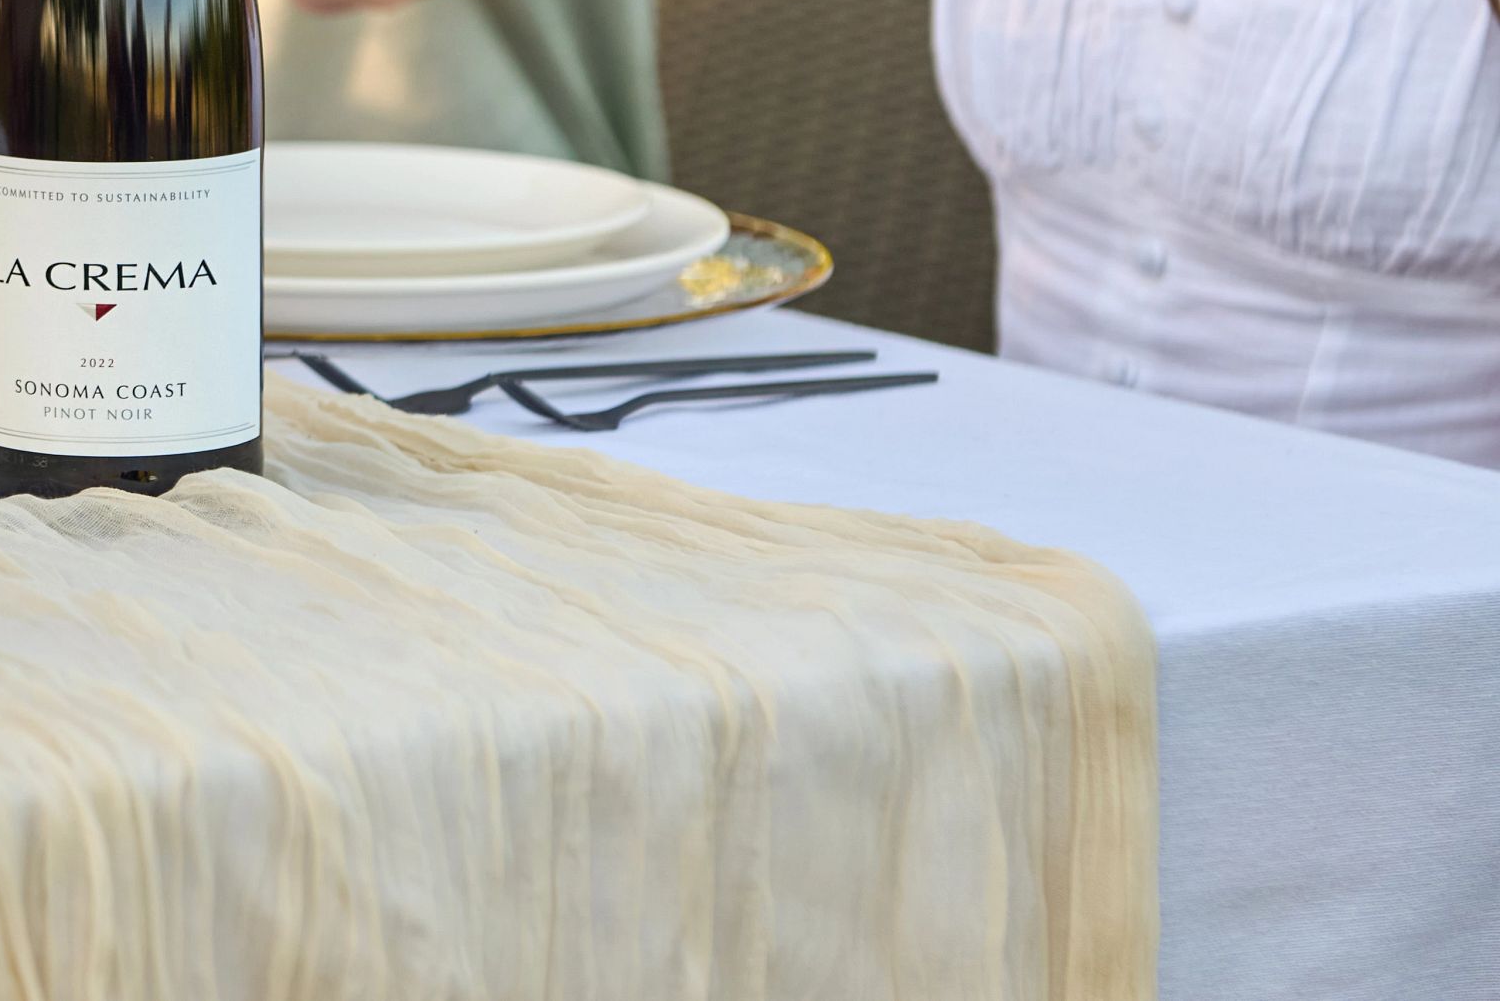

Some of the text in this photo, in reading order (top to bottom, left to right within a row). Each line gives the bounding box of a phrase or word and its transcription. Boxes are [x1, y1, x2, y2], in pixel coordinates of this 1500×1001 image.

[71, 192, 89, 203] TO
[97, 189, 211, 203] SUSTAINABILITY
[45, 259, 217, 291] CREMA
[80, 358, 115, 368] 2022
[15, 379, 187, 400] SONOMA COAST
[44, 406, 153, 421] PINOT NOIR
